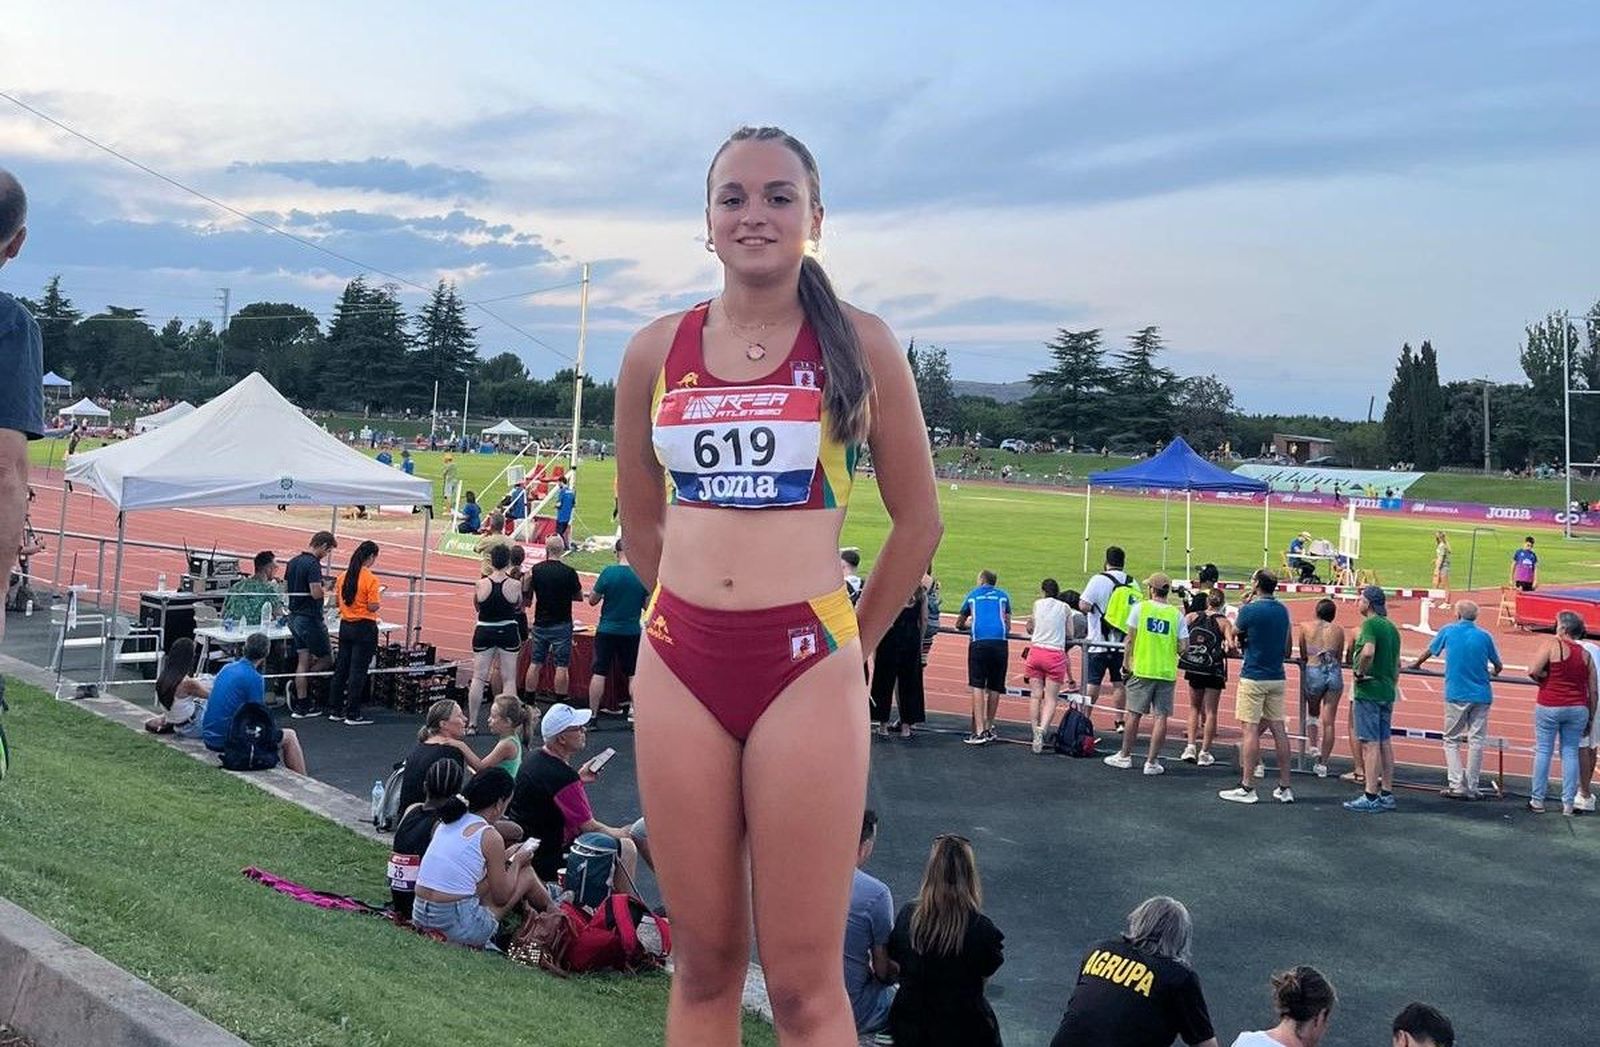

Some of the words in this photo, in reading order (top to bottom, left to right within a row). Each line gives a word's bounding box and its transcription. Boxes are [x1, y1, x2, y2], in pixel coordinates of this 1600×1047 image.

[721, 393, 789, 410] RFEA
[693, 426, 776, 469] 619
[1151, 619, 1165, 633] 50
[1081, 949, 1155, 998] AGRUPA
